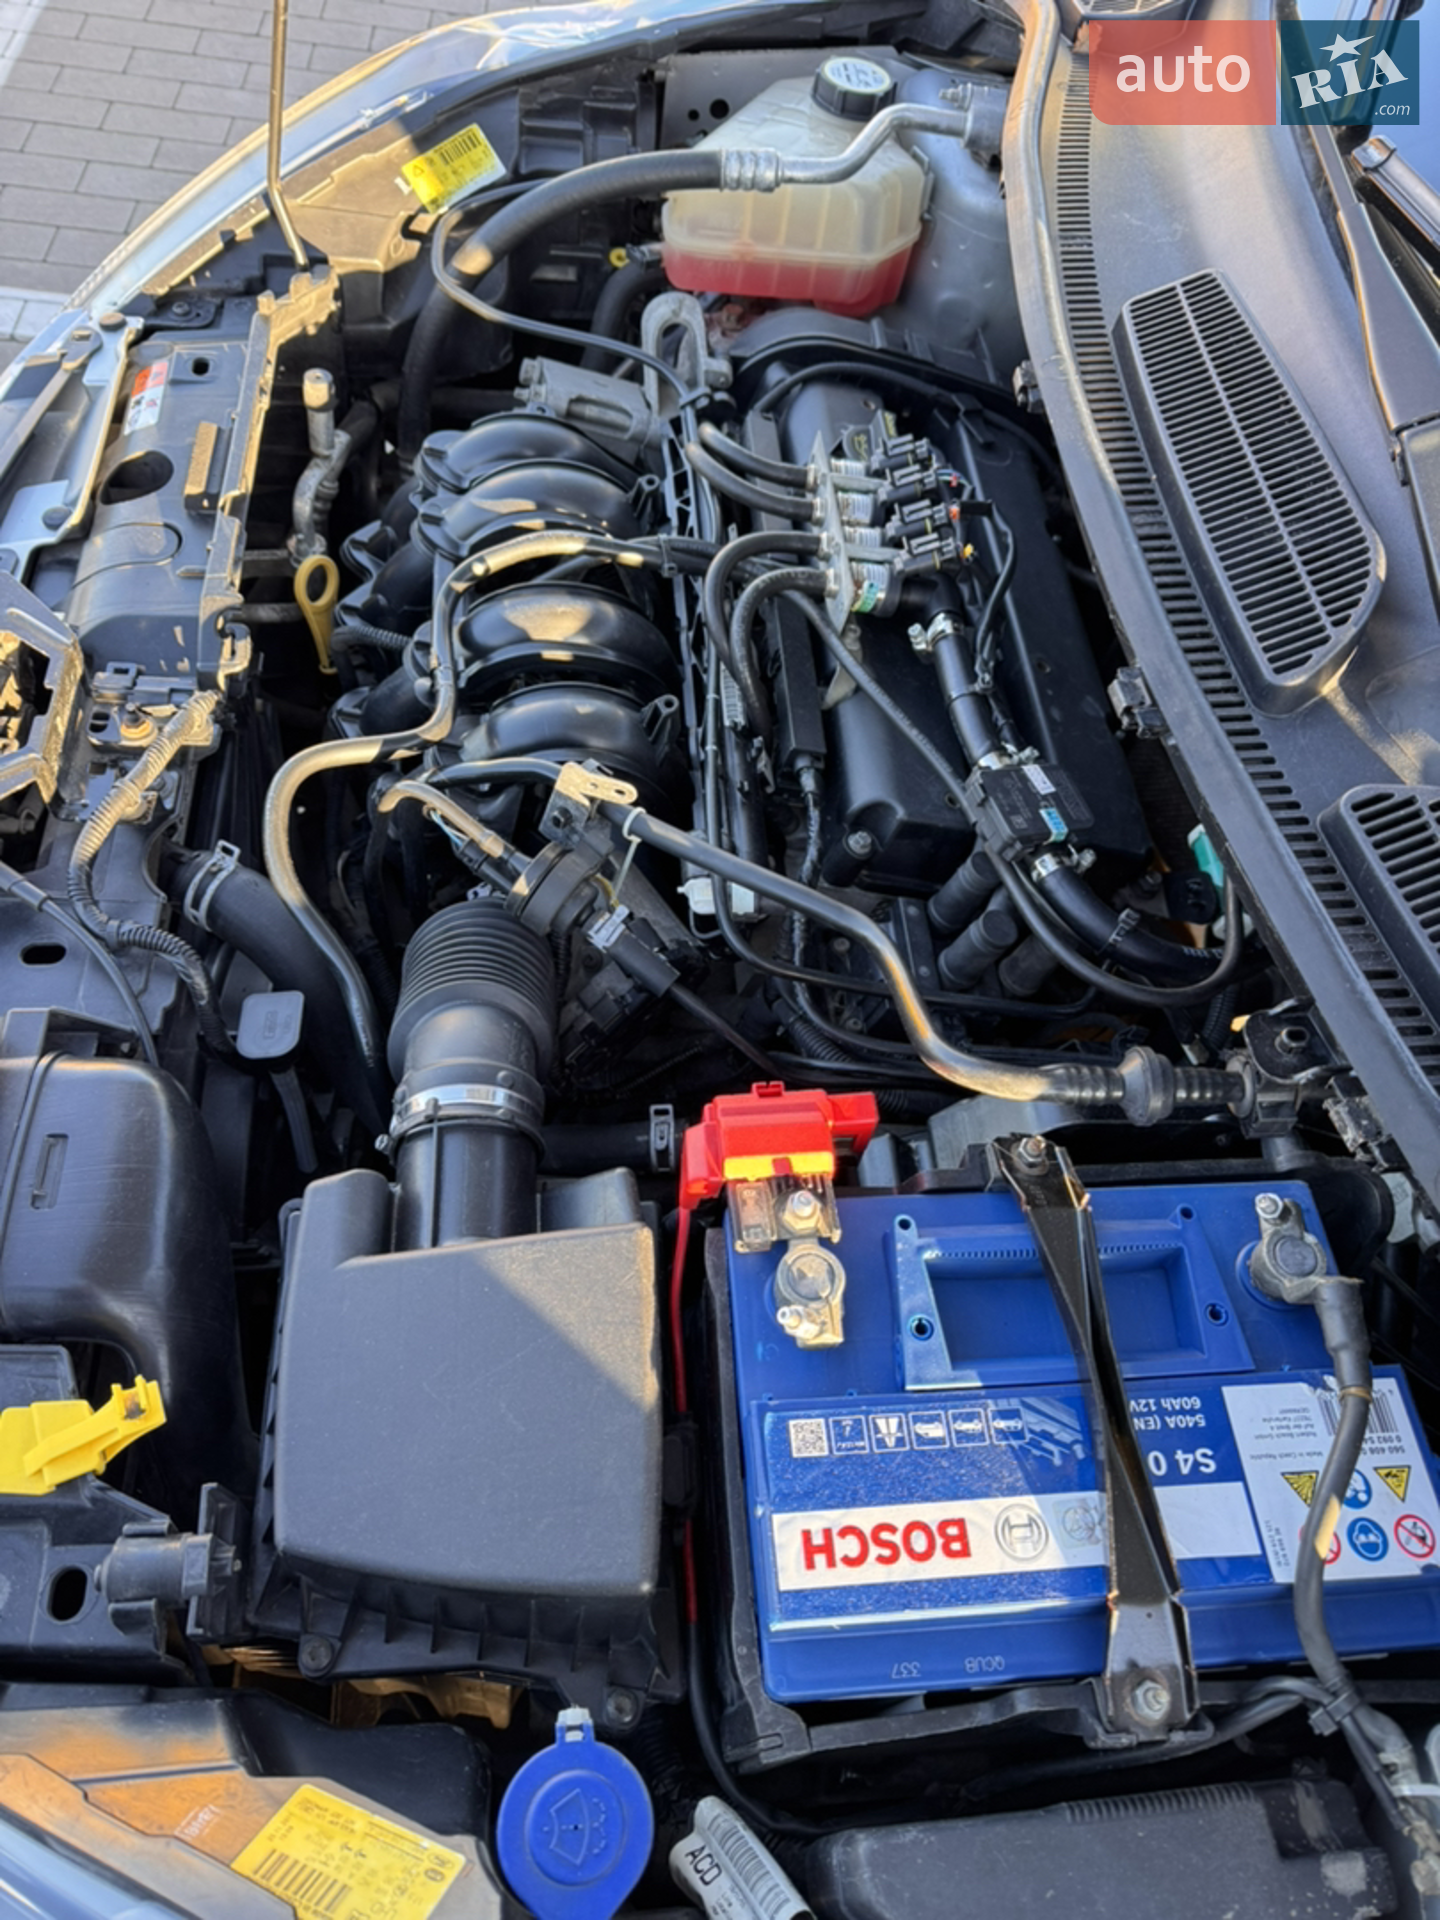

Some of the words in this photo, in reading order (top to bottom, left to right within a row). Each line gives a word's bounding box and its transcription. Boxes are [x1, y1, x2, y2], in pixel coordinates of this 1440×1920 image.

[1129, 1398, 1157, 1413] 12V
[1160, 1396, 1202, 1411] 60Ah
[1164, 1413, 1206, 1429] 540A
[1174, 1447, 1217, 1476] S4
[801, 1517, 972, 1573] BOSCH
[891, 1661, 921, 1679] 337
